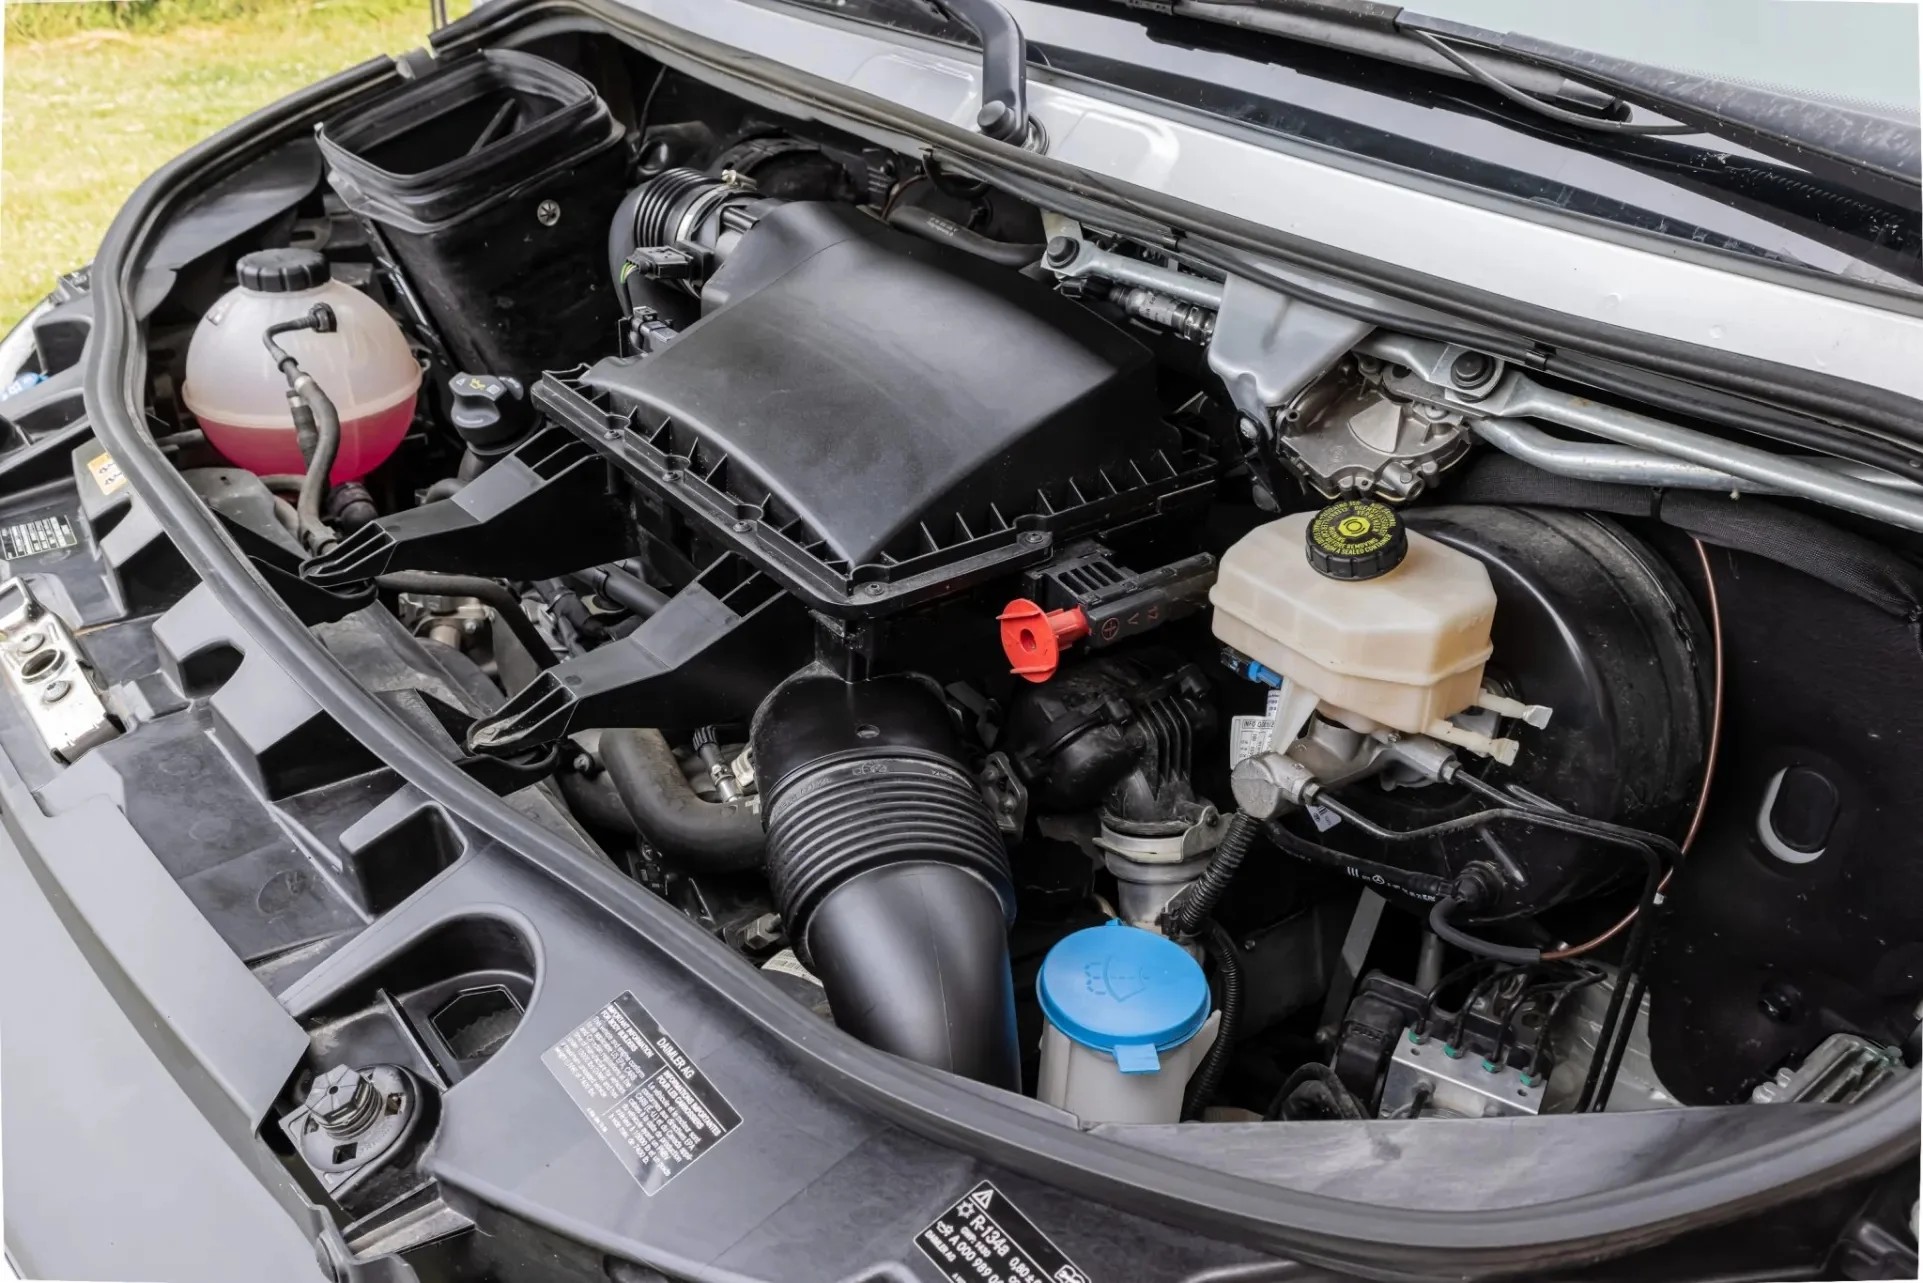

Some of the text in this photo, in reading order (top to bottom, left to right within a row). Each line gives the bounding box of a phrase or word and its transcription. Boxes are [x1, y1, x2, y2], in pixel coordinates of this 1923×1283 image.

[600, 1009, 612, 1020] FOR
[616, 1029, 638, 1052] BUILDERS
[606, 1004, 654, 1058] IMPORTANT INFORMATION
[627, 1058, 646, 1078] conform
[655, 1036, 696, 1079] DAIMLER AG
[655, 1074, 705, 1130] POUR LES CARROSSIERS
[662, 1069, 722, 1137] INFORMATIONS IMPORTANTES
[924, 1229, 956, 1262] DAIMLER AG
[948, 1235, 960, 1246] A
[956, 1241, 976, 1261] 000
[972, 1258, 992, 1277] 989
[970, 1215, 1010, 1256] R-134a
[975, 1241, 991, 1258] 1430
